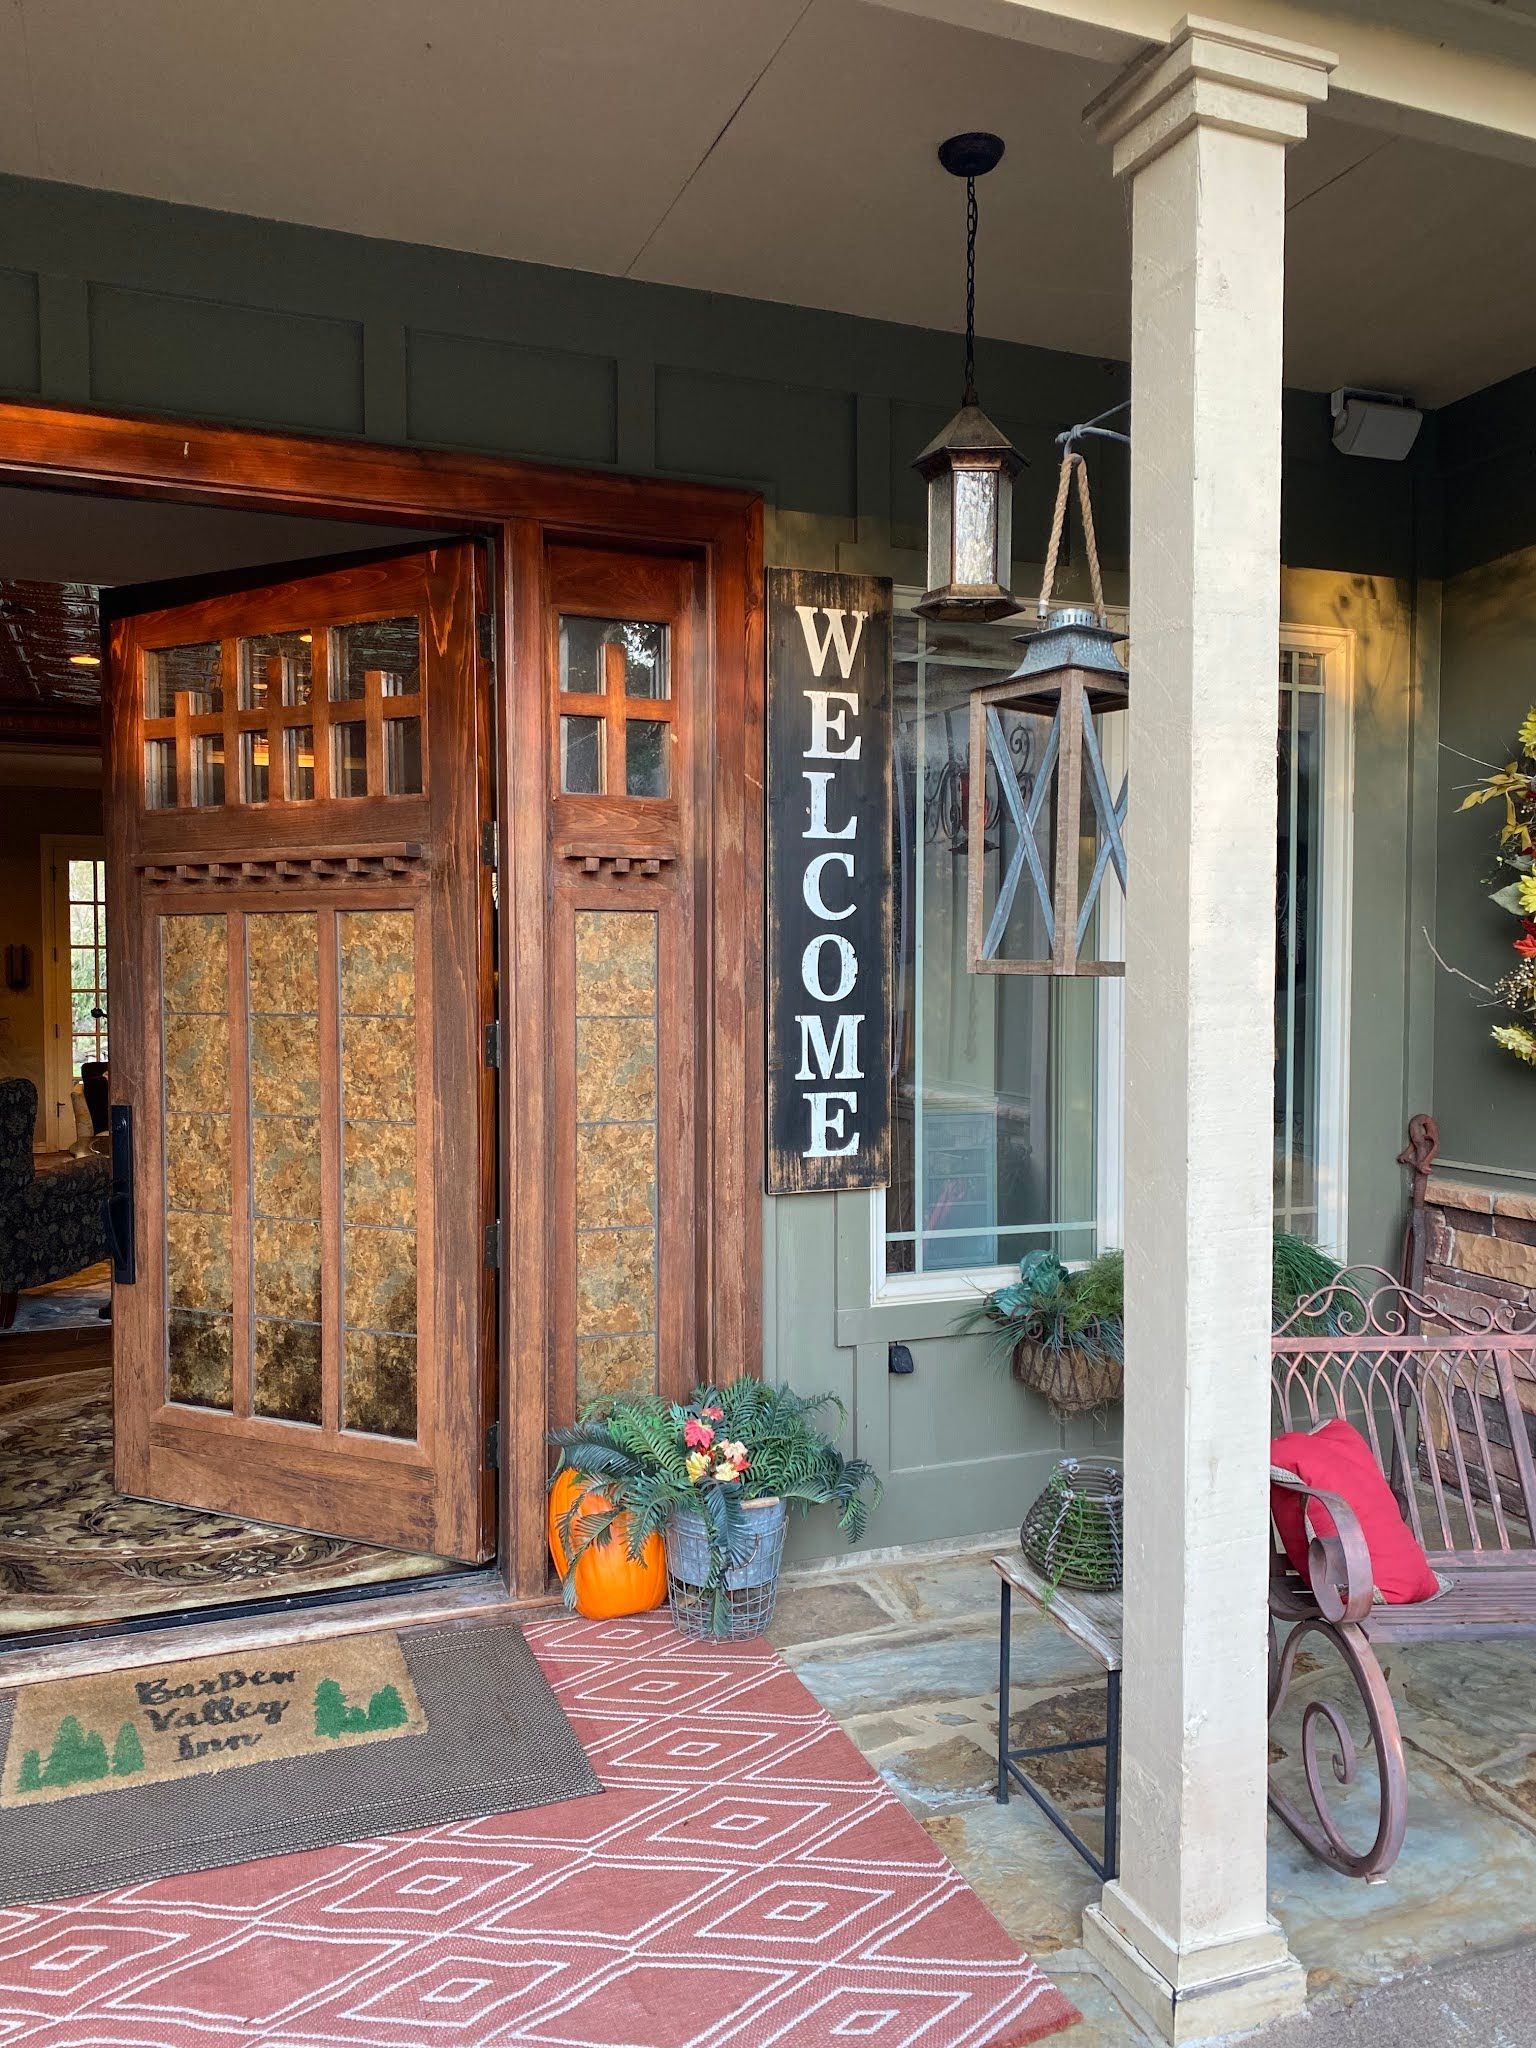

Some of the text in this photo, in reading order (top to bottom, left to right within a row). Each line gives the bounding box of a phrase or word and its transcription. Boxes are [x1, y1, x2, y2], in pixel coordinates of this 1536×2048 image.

[795, 605, 868, 1158] WELCOME
[143, 1695, 290, 1732] Valley
[173, 1732, 263, 1763] Inn
